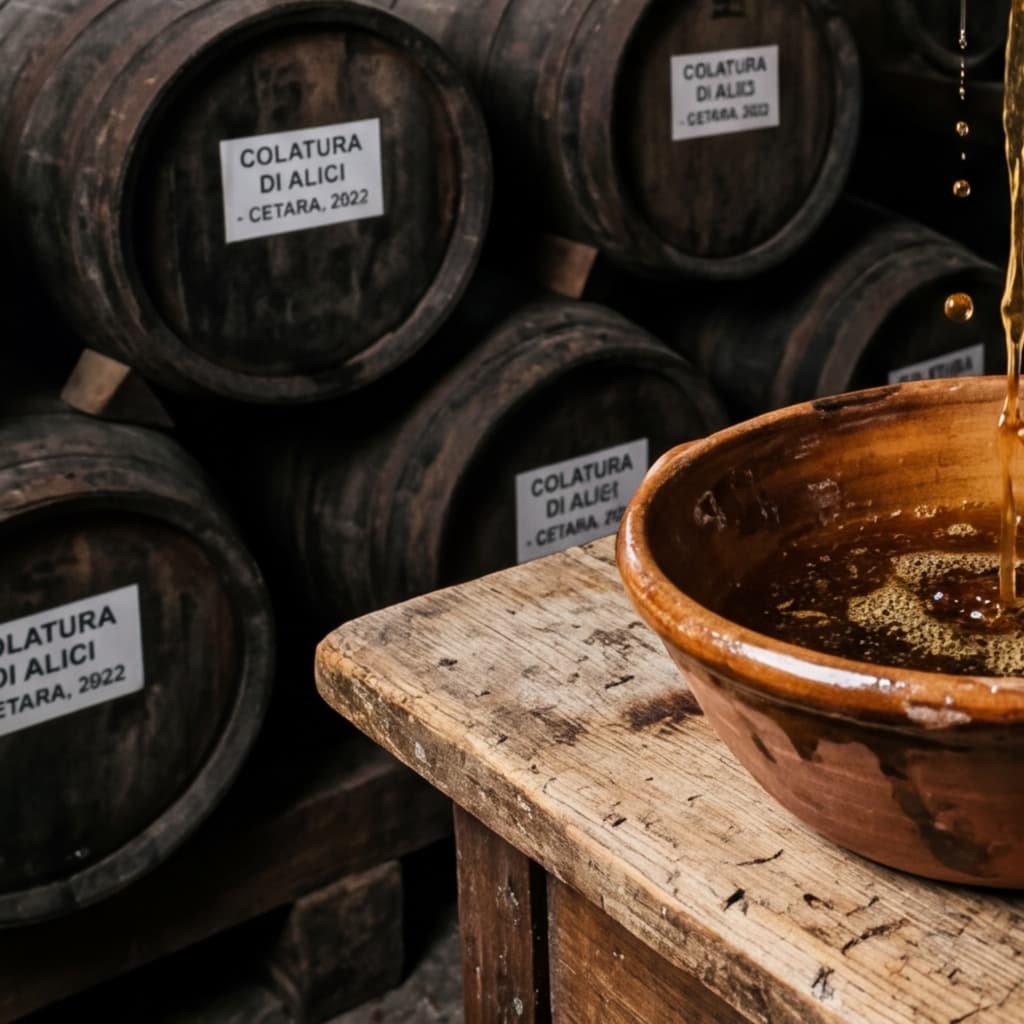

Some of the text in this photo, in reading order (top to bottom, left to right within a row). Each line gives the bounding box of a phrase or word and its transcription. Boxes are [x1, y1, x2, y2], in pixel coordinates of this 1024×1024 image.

[240, 133, 362, 168] COLATURA
[260, 163, 345, 194] DI ALICI
[331, 189, 368, 209] 2022
[531, 453, 633, 497] COLATURA
[546, 498, 565, 518] DI
[24, 640, 95, 681] ALICI
